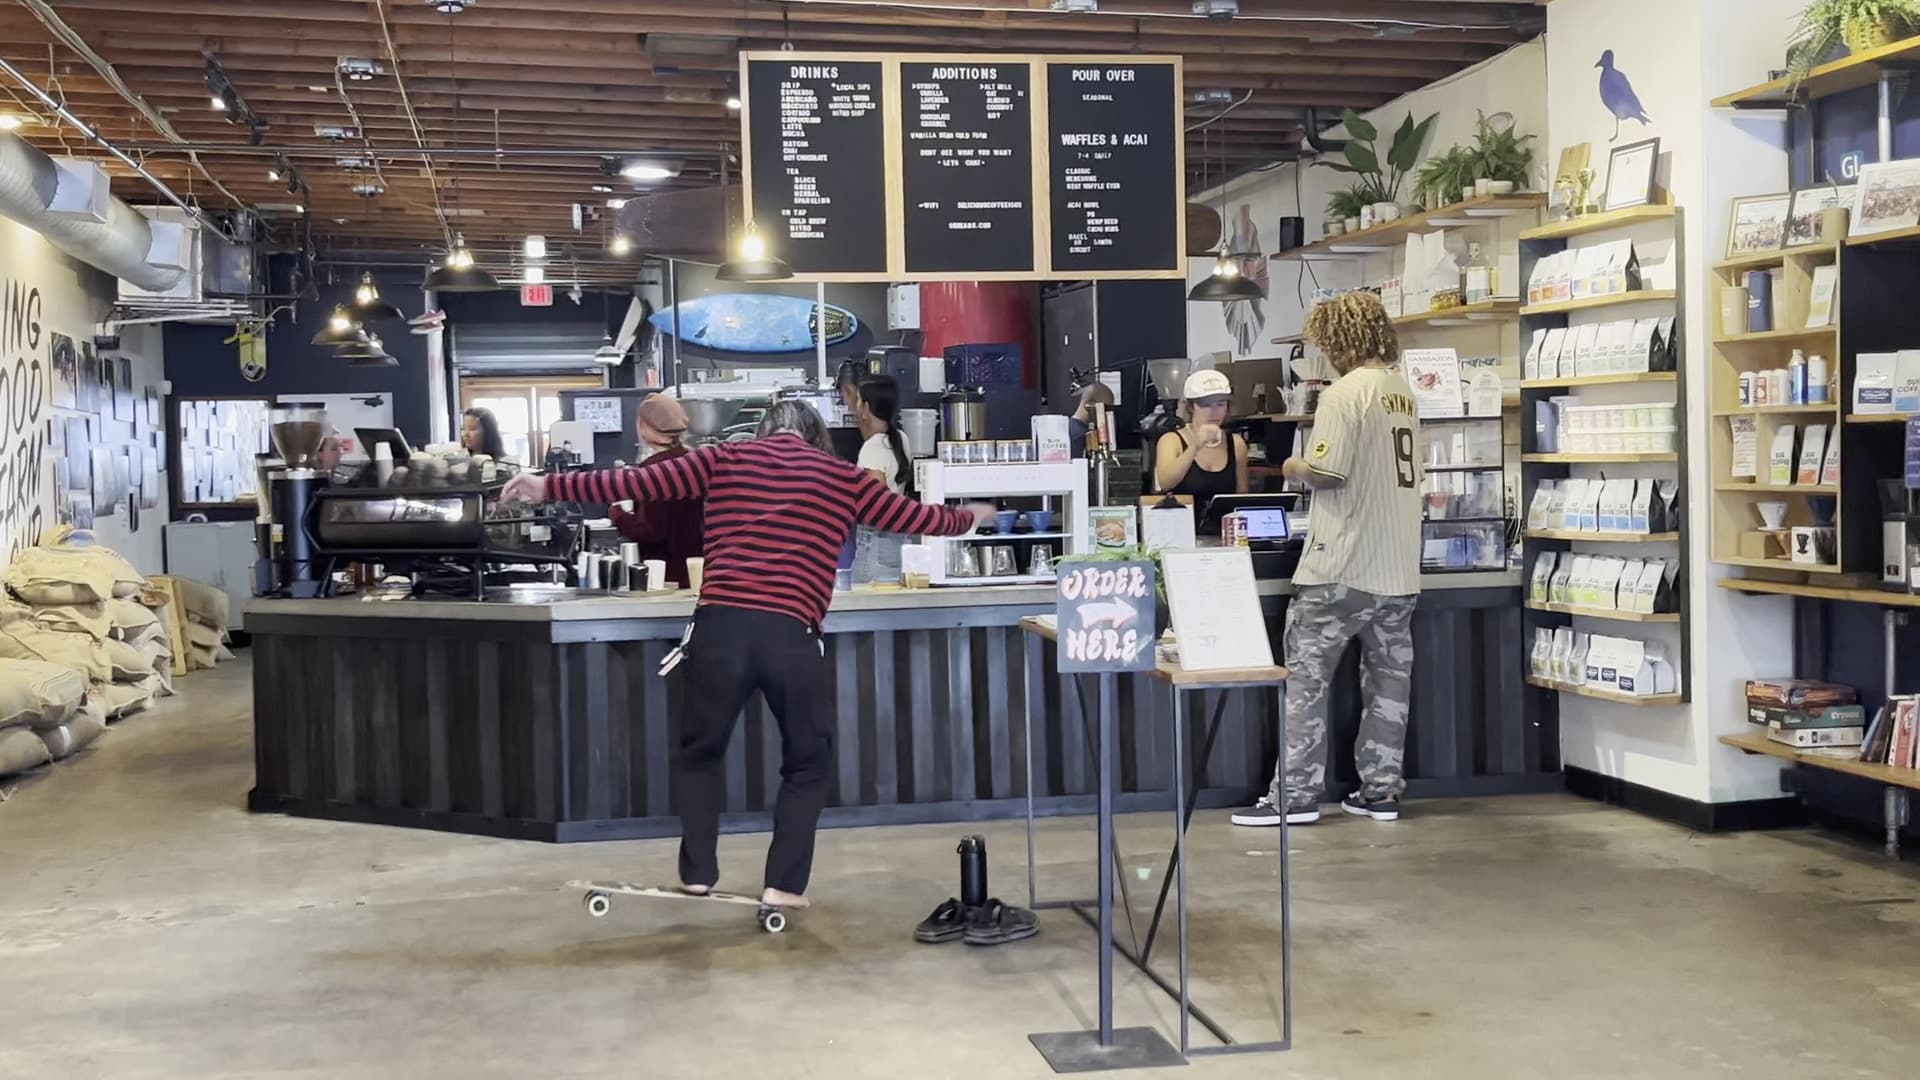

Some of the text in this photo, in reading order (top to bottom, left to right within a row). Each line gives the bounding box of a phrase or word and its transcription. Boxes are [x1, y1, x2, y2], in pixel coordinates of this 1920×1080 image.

[791, 66, 839, 79] DRINKS
[932, 67, 998, 80] ADDITIONS
[1072, 70, 1135, 81] POUR OVER
[1061, 134, 1148, 146] WAFFLES & ACAI
[2, 277, 41, 358] ING
[1391, 426, 1415, 489] 19
[1061, 566, 1147, 600] ORDER
[1066, 628, 1138, 662] HERE
